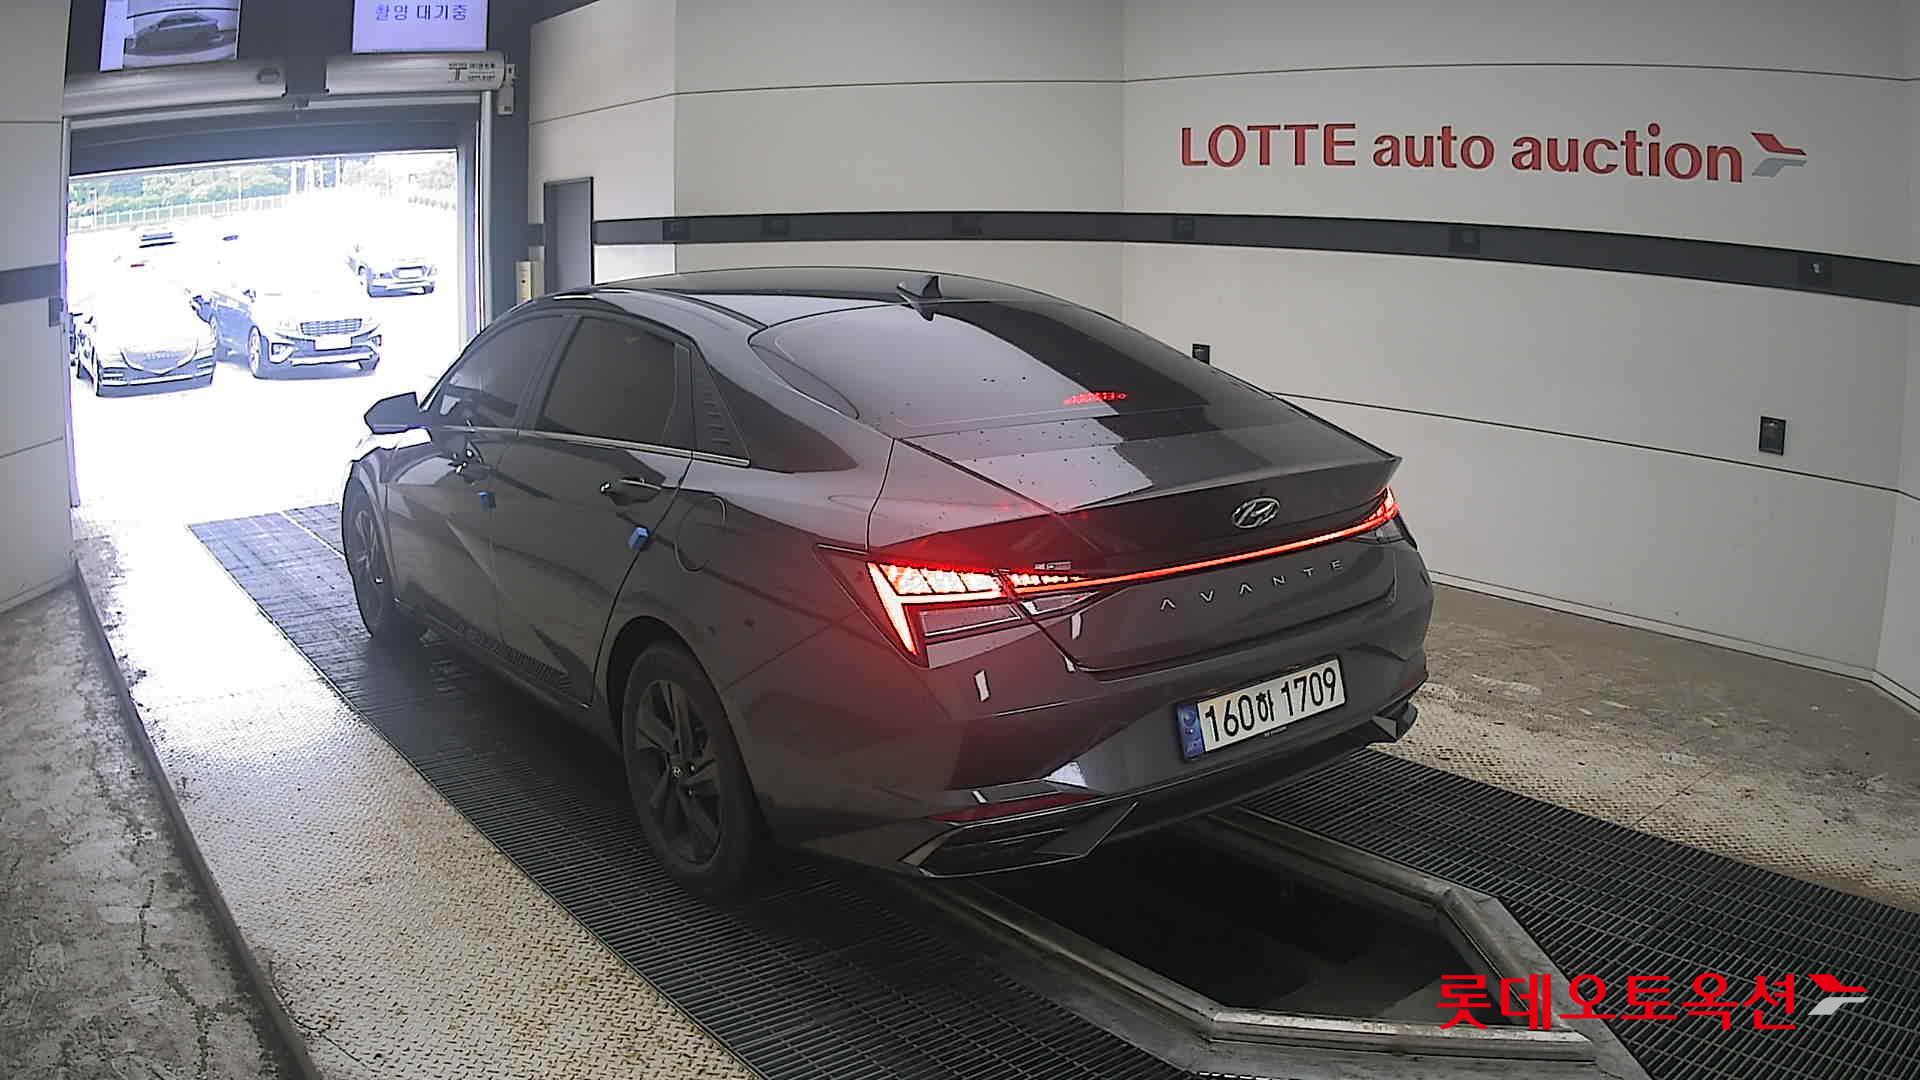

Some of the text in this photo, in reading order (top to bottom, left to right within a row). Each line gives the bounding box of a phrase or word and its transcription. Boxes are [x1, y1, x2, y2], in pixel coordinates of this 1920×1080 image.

[416, 4, 467, 21] 대기중
[1181, 124, 1743, 182] LOTTE auto auction
[1160, 560, 1344, 610] AVANTE
[1205, 667, 1336, 742] 160하 1709
